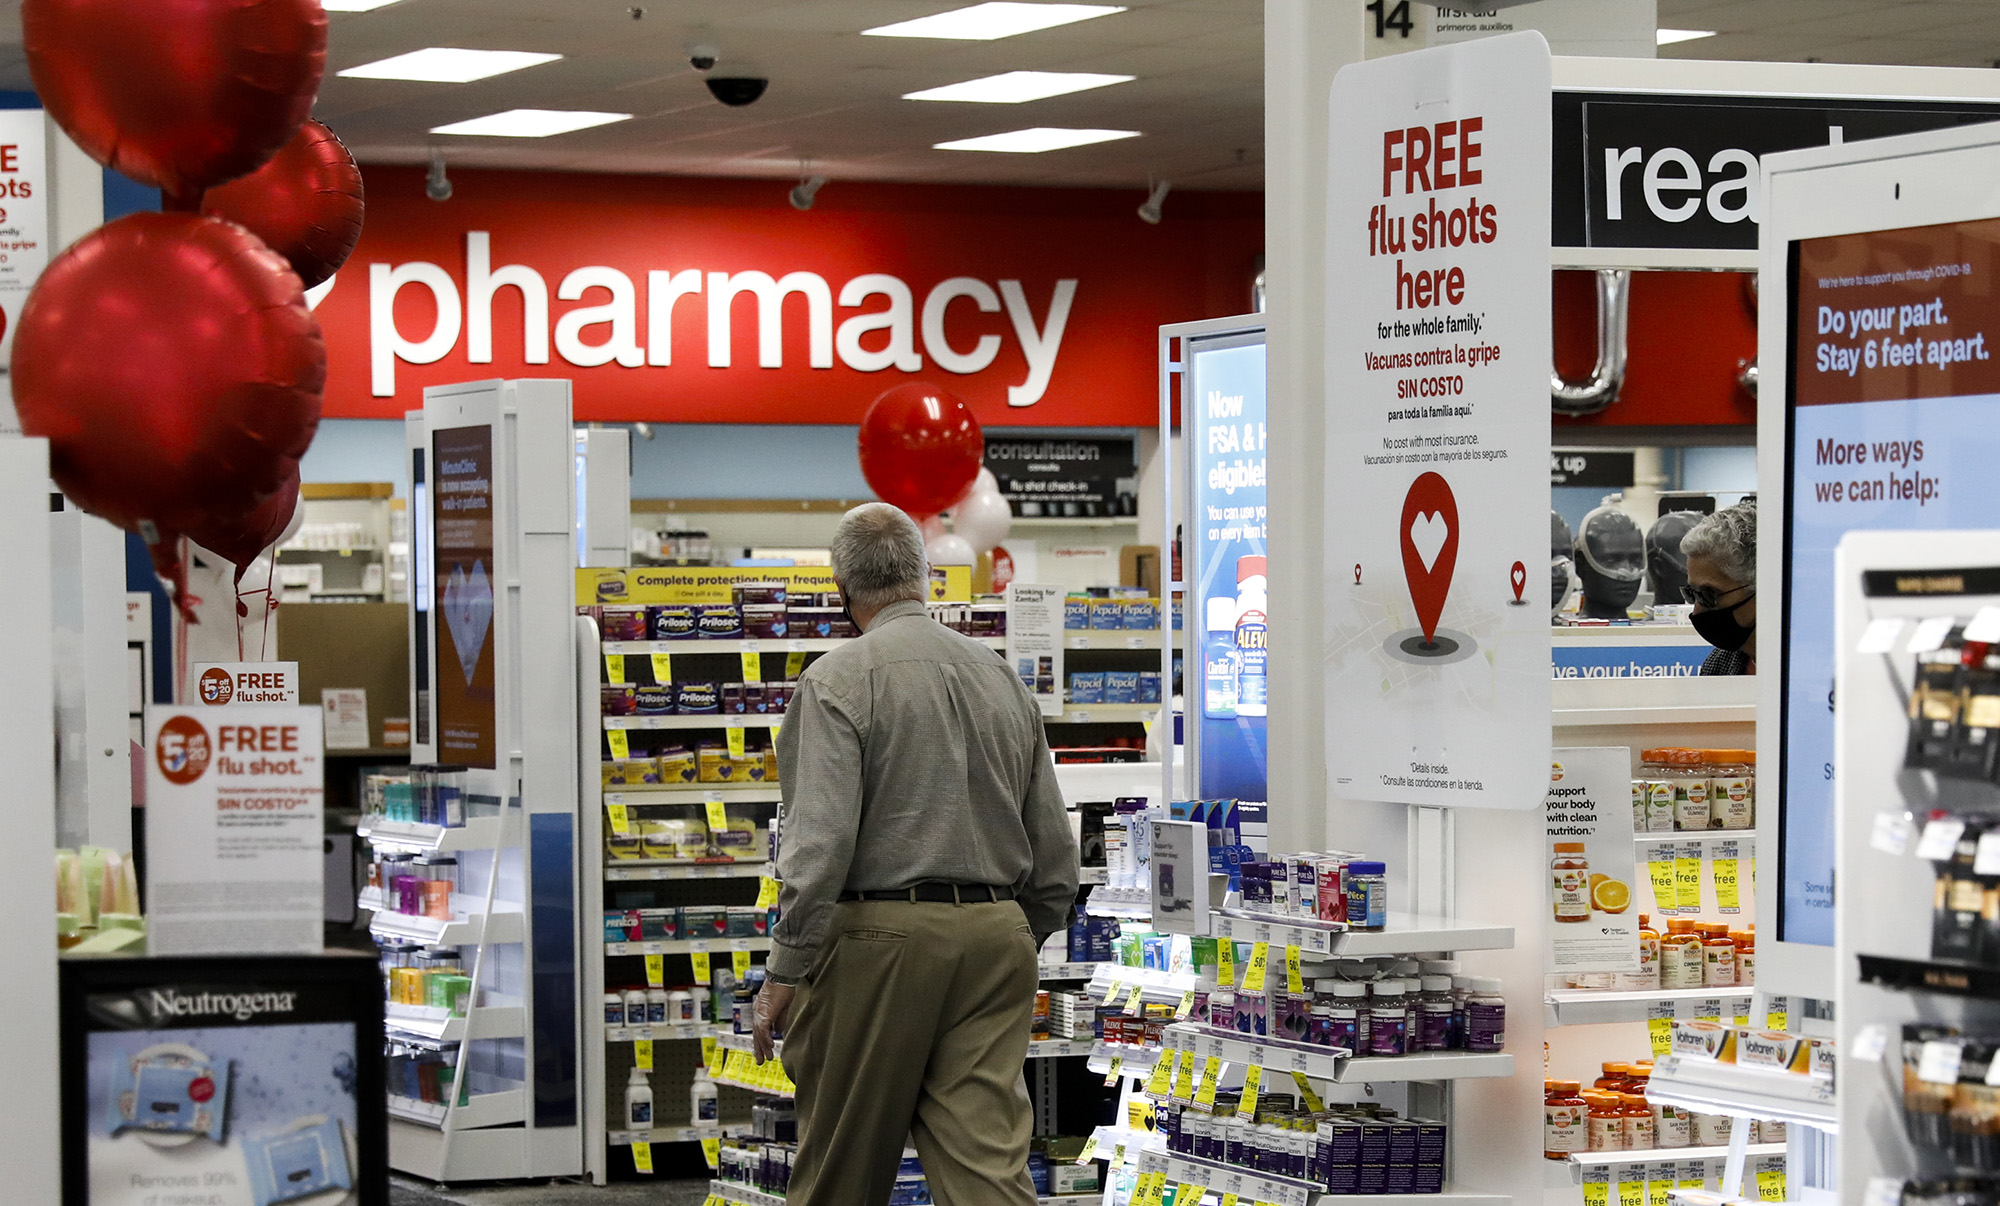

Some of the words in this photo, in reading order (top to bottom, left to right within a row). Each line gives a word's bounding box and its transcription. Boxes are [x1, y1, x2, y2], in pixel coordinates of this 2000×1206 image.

[1366, 0, 1413, 38] 14
[1437, 23, 1477, 33] primeros
[1479, 21, 1514, 32] auxilios
[1383, 116, 1483, 197] FREE
[1368, 204, 1406, 256] flu
[1412, 197, 1497, 251] shots
[1396, 259, 1465, 310] here
[1864, 272, 1891, 286] support
[368, 231, 1078, 407] pharmacy
[1818, 306, 1845, 334] Do
[1849, 307, 1896, 339] your
[1899, 297, 1949, 336] part.
[1378, 322, 1392, 339] for
[1394, 320, 1410, 338] the
[1413, 317, 1444, 336] whole
[1365, 352, 1413, 371] Vacunas
[1414, 347, 1452, 367] contra
[1455, 344, 1466, 363] la
[1468, 341, 1500, 368] gripe
[1816, 343, 1860, 377] Stay
[1864, 339, 1877, 368] 6
[1881, 336, 1923, 367] feet
[1927, 332, 1990, 371] apart.
[1397, 378, 1418, 399] SIN
[1420, 375, 1463, 397] COSTO
[1208, 391, 1243, 418] Now
[1388, 410, 1403, 423] para
[1404, 407, 1421, 419] toda
[1421, 407, 1428, 418] la
[1429, 404, 1453, 417] familia
[1208, 424, 1239, 454] FSA
[1242, 423, 1255, 452] &
[1383, 438, 1393, 449] No
[1393, 436, 1408, 448] cost
[1409, 435, 1424, 447] with
[1424, 435, 1442, 447] most
[1443, 434, 1479, 446] insurance.
[987, 442, 1100, 461] consultation
[1816, 438, 1867, 465] More
[1872, 439, 1924, 469] ways
[1563, 457, 1586, 475] up
[1208, 458, 1266, 495] eligible!
[1010, 480, 1023, 492] flu
[1025, 480, 1047, 492] shot
[1047, 480, 1088, 492] check-in
[1815, 481, 1843, 502] we
[1848, 479, 1884, 501] can
[1889, 471, 1939, 506] help:
[1207, 505, 1223, 521] You
[1224, 506, 1239, 520] can
[1240, 505, 1255, 519] use
[1208, 529, 1220, 541] on
[1220, 526, 1243, 543] every
[637, 575, 696, 588] Complete
[697, 574, 762, 588] protection
[1015, 588, 1043, 597] Looking
[1045, 588, 1056, 596] for
[1092, 604, 1122, 616] Pepcid
[1124, 604, 1153, 615] Pepcid
[658, 617, 694, 628] Prilosec
[699, 616, 740, 628] Prilosec
[1237, 627, 1267, 650] ALEV
[1582, 664, 1625, 679] your
[1629, 662, 1695, 678] beauty
[237, 673, 285, 688] FREE
[1073, 677, 1102, 690] Pepcid
[1107, 677, 1137, 689] Pepcid
[237, 691, 253, 702] flu
[636, 693, 672, 704] Prilosec
[679, 692, 716, 704] Prilosec
[217, 726, 298, 752] FREE
[217, 756, 244, 775] flu
[1547, 786, 1585, 798] Support
[217, 799, 241, 810] SIN
[1546, 801, 1569, 811] your
[1570, 799, 1596, 811] body
[1546, 813, 1568, 822] with
[1570, 812, 1597, 822] clean
[1651, 875, 1672, 886] free
[1676, 871, 1698, 883] free
[1714, 872, 1736, 884] free
[150, 990, 296, 1020] Neutrogena
[1103, 1018, 1121, 1030] TYLENOL
[1650, 1032, 1671, 1044] free
[1676, 1031, 1704, 1044] Voltaren
[1745, 1040, 1775, 1055] Voltaren
[1157, 1060, 1172, 1073] free
[1179, 1063, 1192, 1077] free
[1203, 1068, 1217, 1082] free
[1245, 1078, 1258, 1091] free
[130, 1173, 198, 1189] Removes
[204, 1172, 237, 1187] 99%
[1759, 1186, 1778, 1197] free
[1584, 1196, 1605, 1206] free
[1620, 1195, 1641, 1206] free
